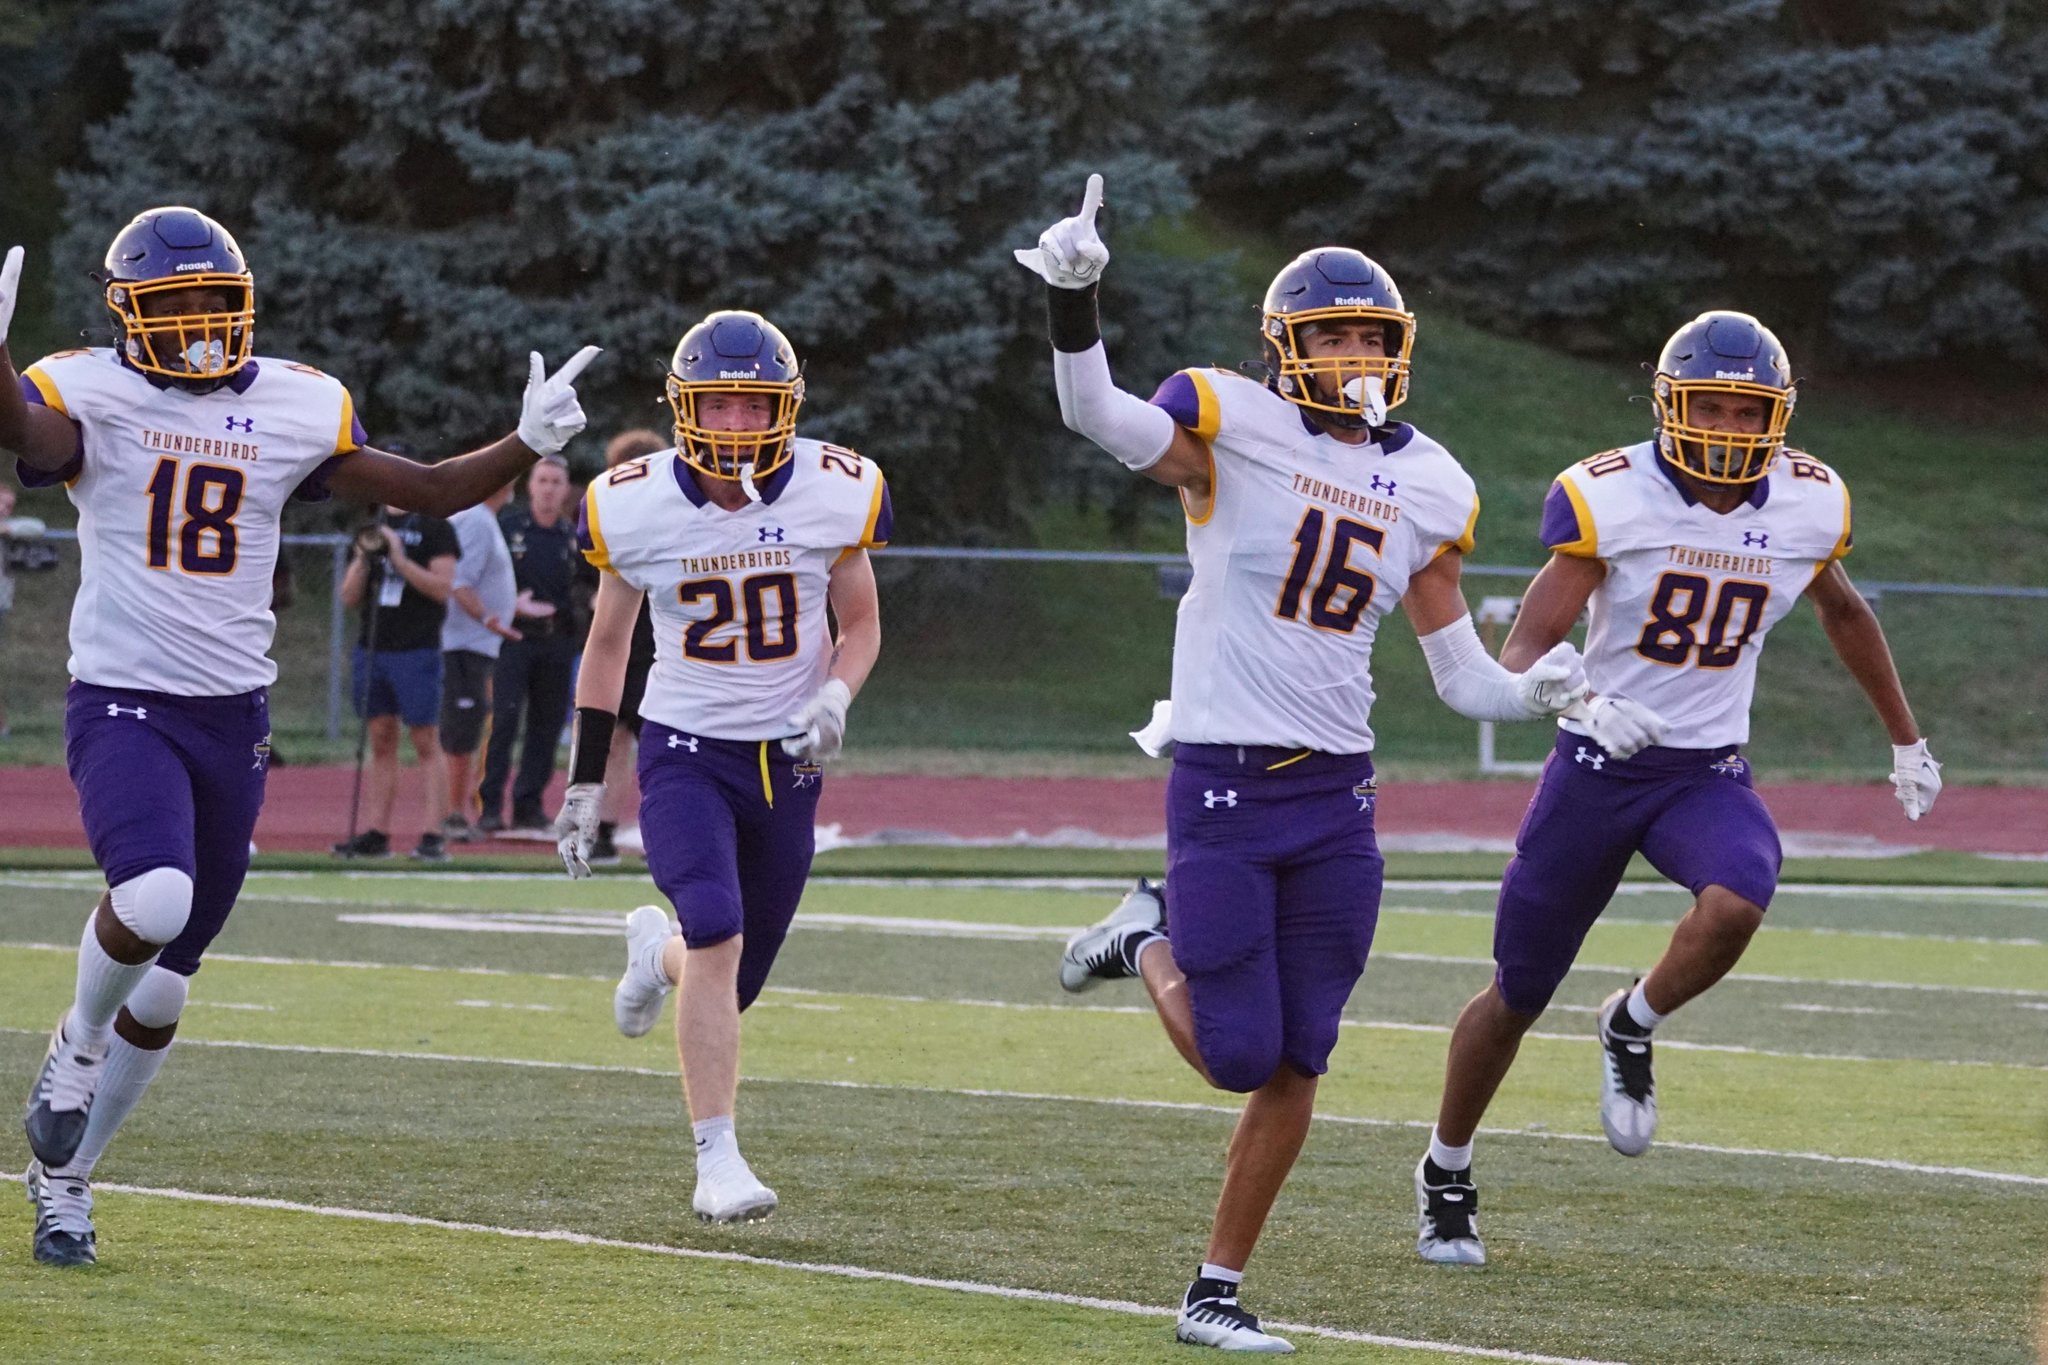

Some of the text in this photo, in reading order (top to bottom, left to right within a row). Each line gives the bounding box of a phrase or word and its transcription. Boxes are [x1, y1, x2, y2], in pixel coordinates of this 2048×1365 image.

[1335, 297, 1374, 306] Riddell
[720, 370, 757, 379] Riddell
[143, 430, 259, 460] THUNDERBIRDS
[145, 455, 246, 576] 18
[1293, 474, 1400, 522] THUNDERBIRDS
[681, 550, 791, 572] THUNDERBIRDS
[1274, 504, 1386, 634] 16
[1667, 545, 1773, 574] THUNDERBIRDS
[677, 573, 799, 665] 20
[1635, 571, 1771, 670] 80
